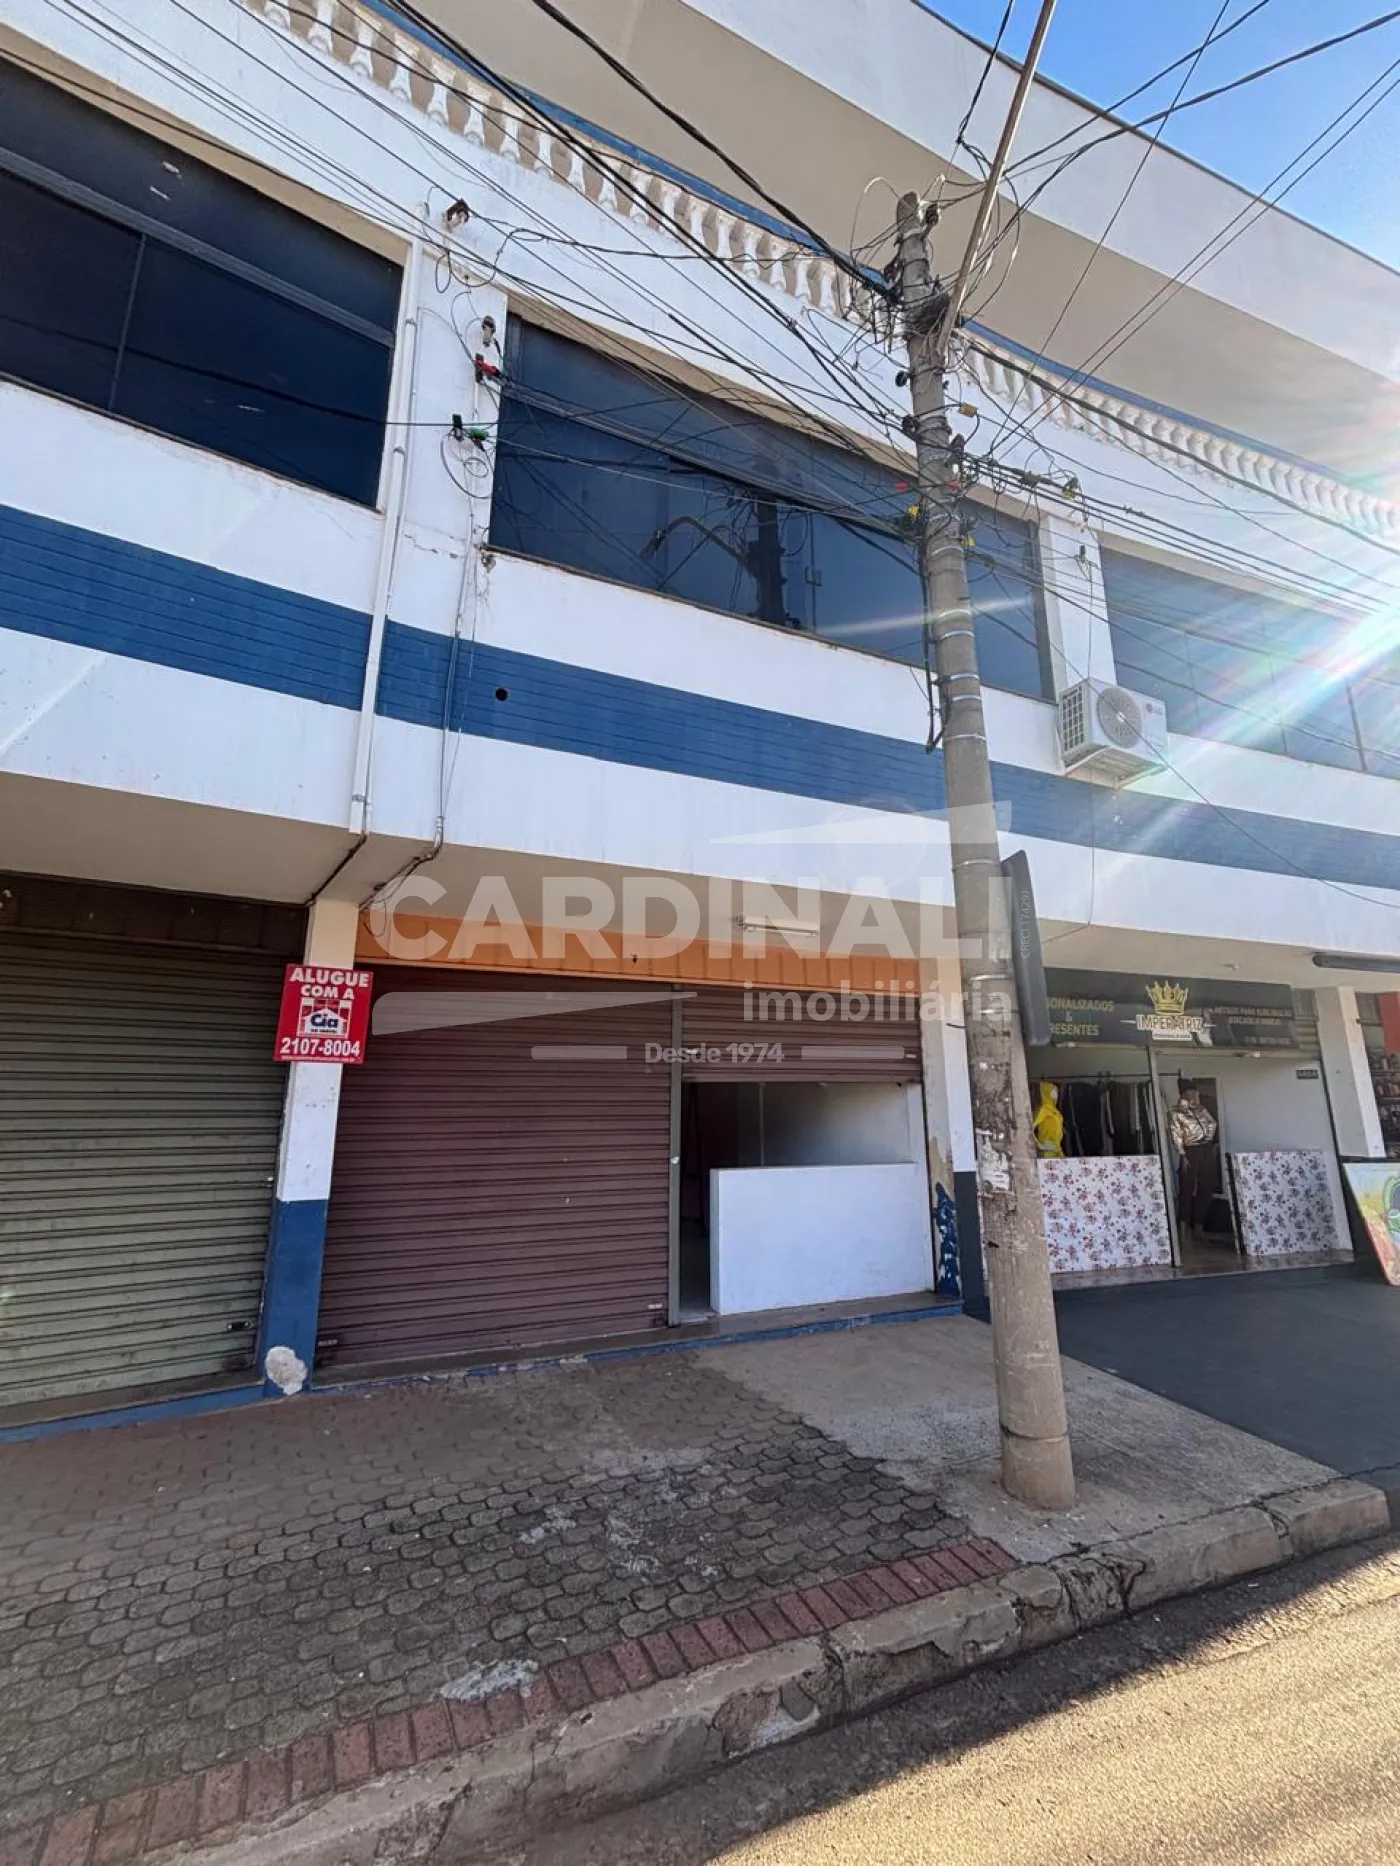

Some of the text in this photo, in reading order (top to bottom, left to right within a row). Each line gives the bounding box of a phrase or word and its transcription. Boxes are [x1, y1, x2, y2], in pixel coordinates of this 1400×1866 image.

[289, 967, 370, 988] ALUGUE
[301, 984, 355, 1000] COM A
[310, 1012, 339, 1028] Cia
[1137, 1014, 1203, 1032] IMPERATRIZ
[280, 1037, 360, 1057] 2107-8004
